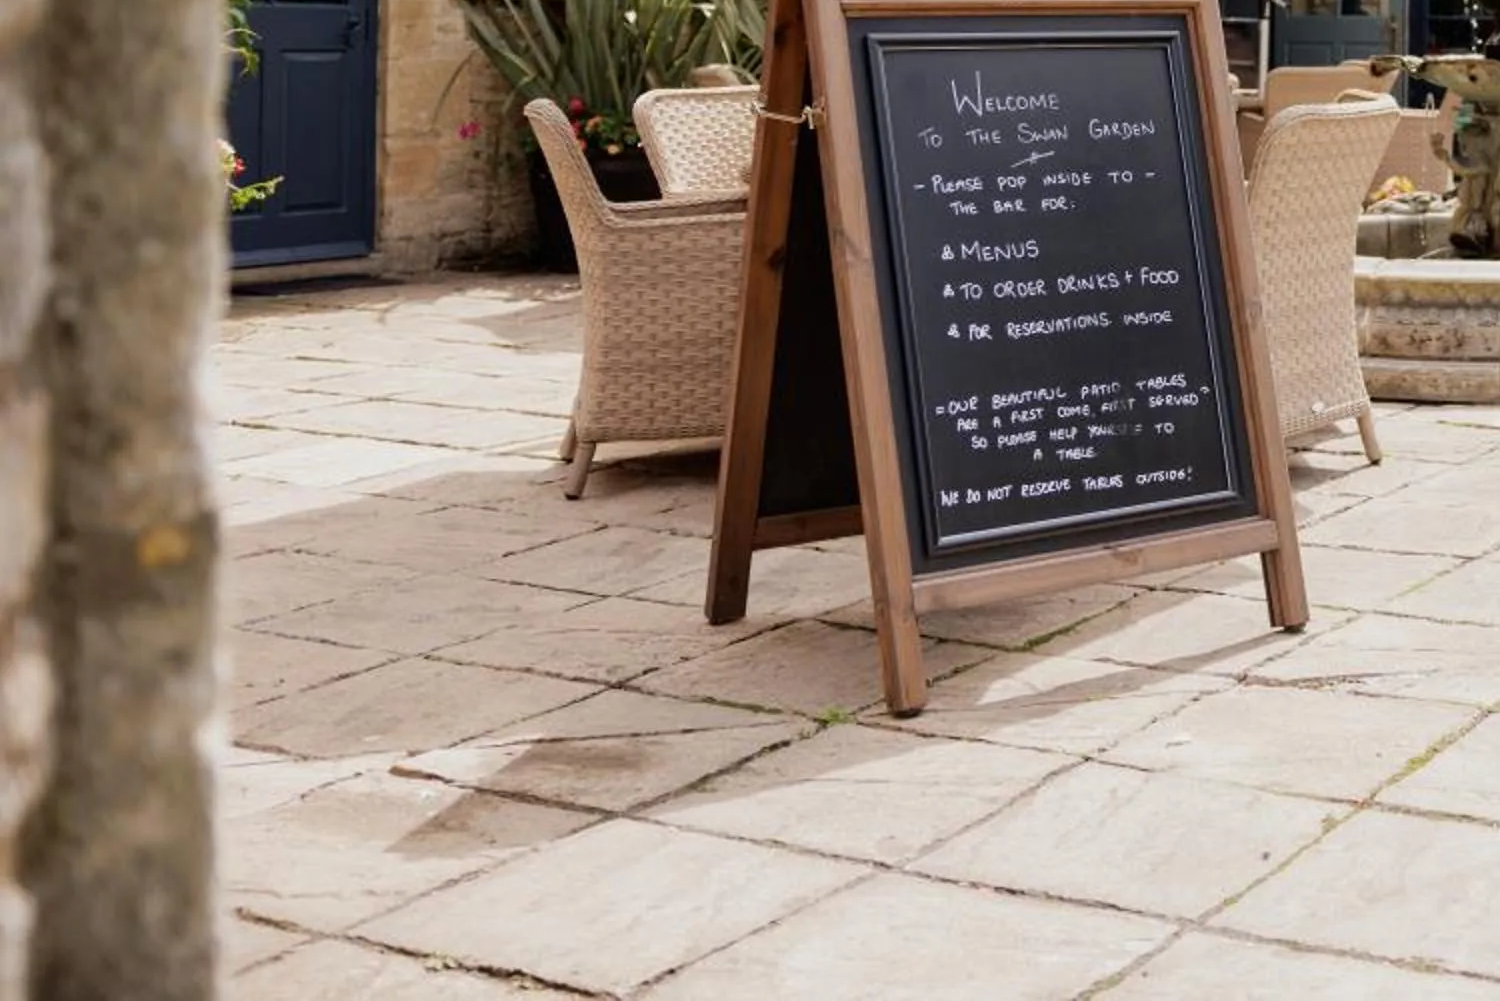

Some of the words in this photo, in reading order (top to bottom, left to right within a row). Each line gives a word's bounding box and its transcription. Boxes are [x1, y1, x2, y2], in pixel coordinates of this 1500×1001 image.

[965, 128, 1002, 145] THE
[1017, 122, 1068, 143] SWAN
[1088, 118, 1155, 140] GARDEN
[931, 174, 984, 194] PLEASE
[997, 176, 1027, 191] POP
[1042, 171, 1093, 186] INSIDE
[1107, 170, 1133, 184] TO
[949, 200, 979, 215] THE
[993, 199, 1027, 214] BAR
[961, 239, 1039, 261] MENUS
[960, 282, 983, 300] TO
[993, 278, 1047, 298] ORDER
[1057, 274, 1120, 294] DRINKS
[1140, 266, 1179, 287] FOOD
[968, 323, 993, 341] FOR
[1123, 310, 1173, 326] INSIDE
[1136, 373, 1187, 391] TABLES
[992, 416, 1002, 429] A
[1011, 408, 1044, 424] FIRST
[1148, 391, 1199, 409] SERVED
[971, 435, 988, 449] SO
[997, 430, 1037, 448] PLEASE
[1049, 426, 1078, 441] HELP
[1154, 422, 1175, 435] TO
[1033, 448, 1043, 462] A
[1055, 446, 1097, 461] TABLE
[940, 489, 959, 507] WE
[965, 488, 981, 504] DO
[987, 484, 1014, 502] NOT
[1021, 478, 1071, 498] RESERVE
